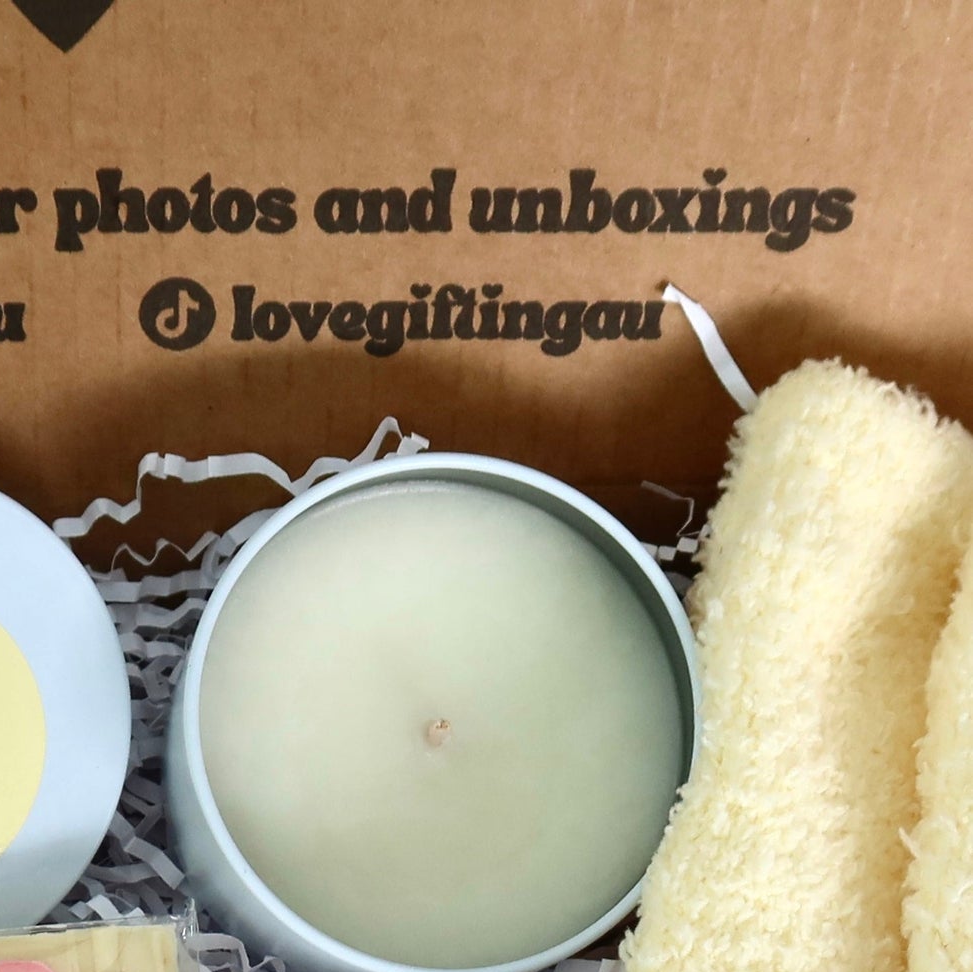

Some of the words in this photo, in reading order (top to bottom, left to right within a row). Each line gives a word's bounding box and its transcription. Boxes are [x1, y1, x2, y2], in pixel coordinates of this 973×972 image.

[53, 168, 297, 252] photos
[314, 168, 456, 234] and
[468, 167, 857, 252] unboxings
[231, 283, 667, 358] lovegiftingau
